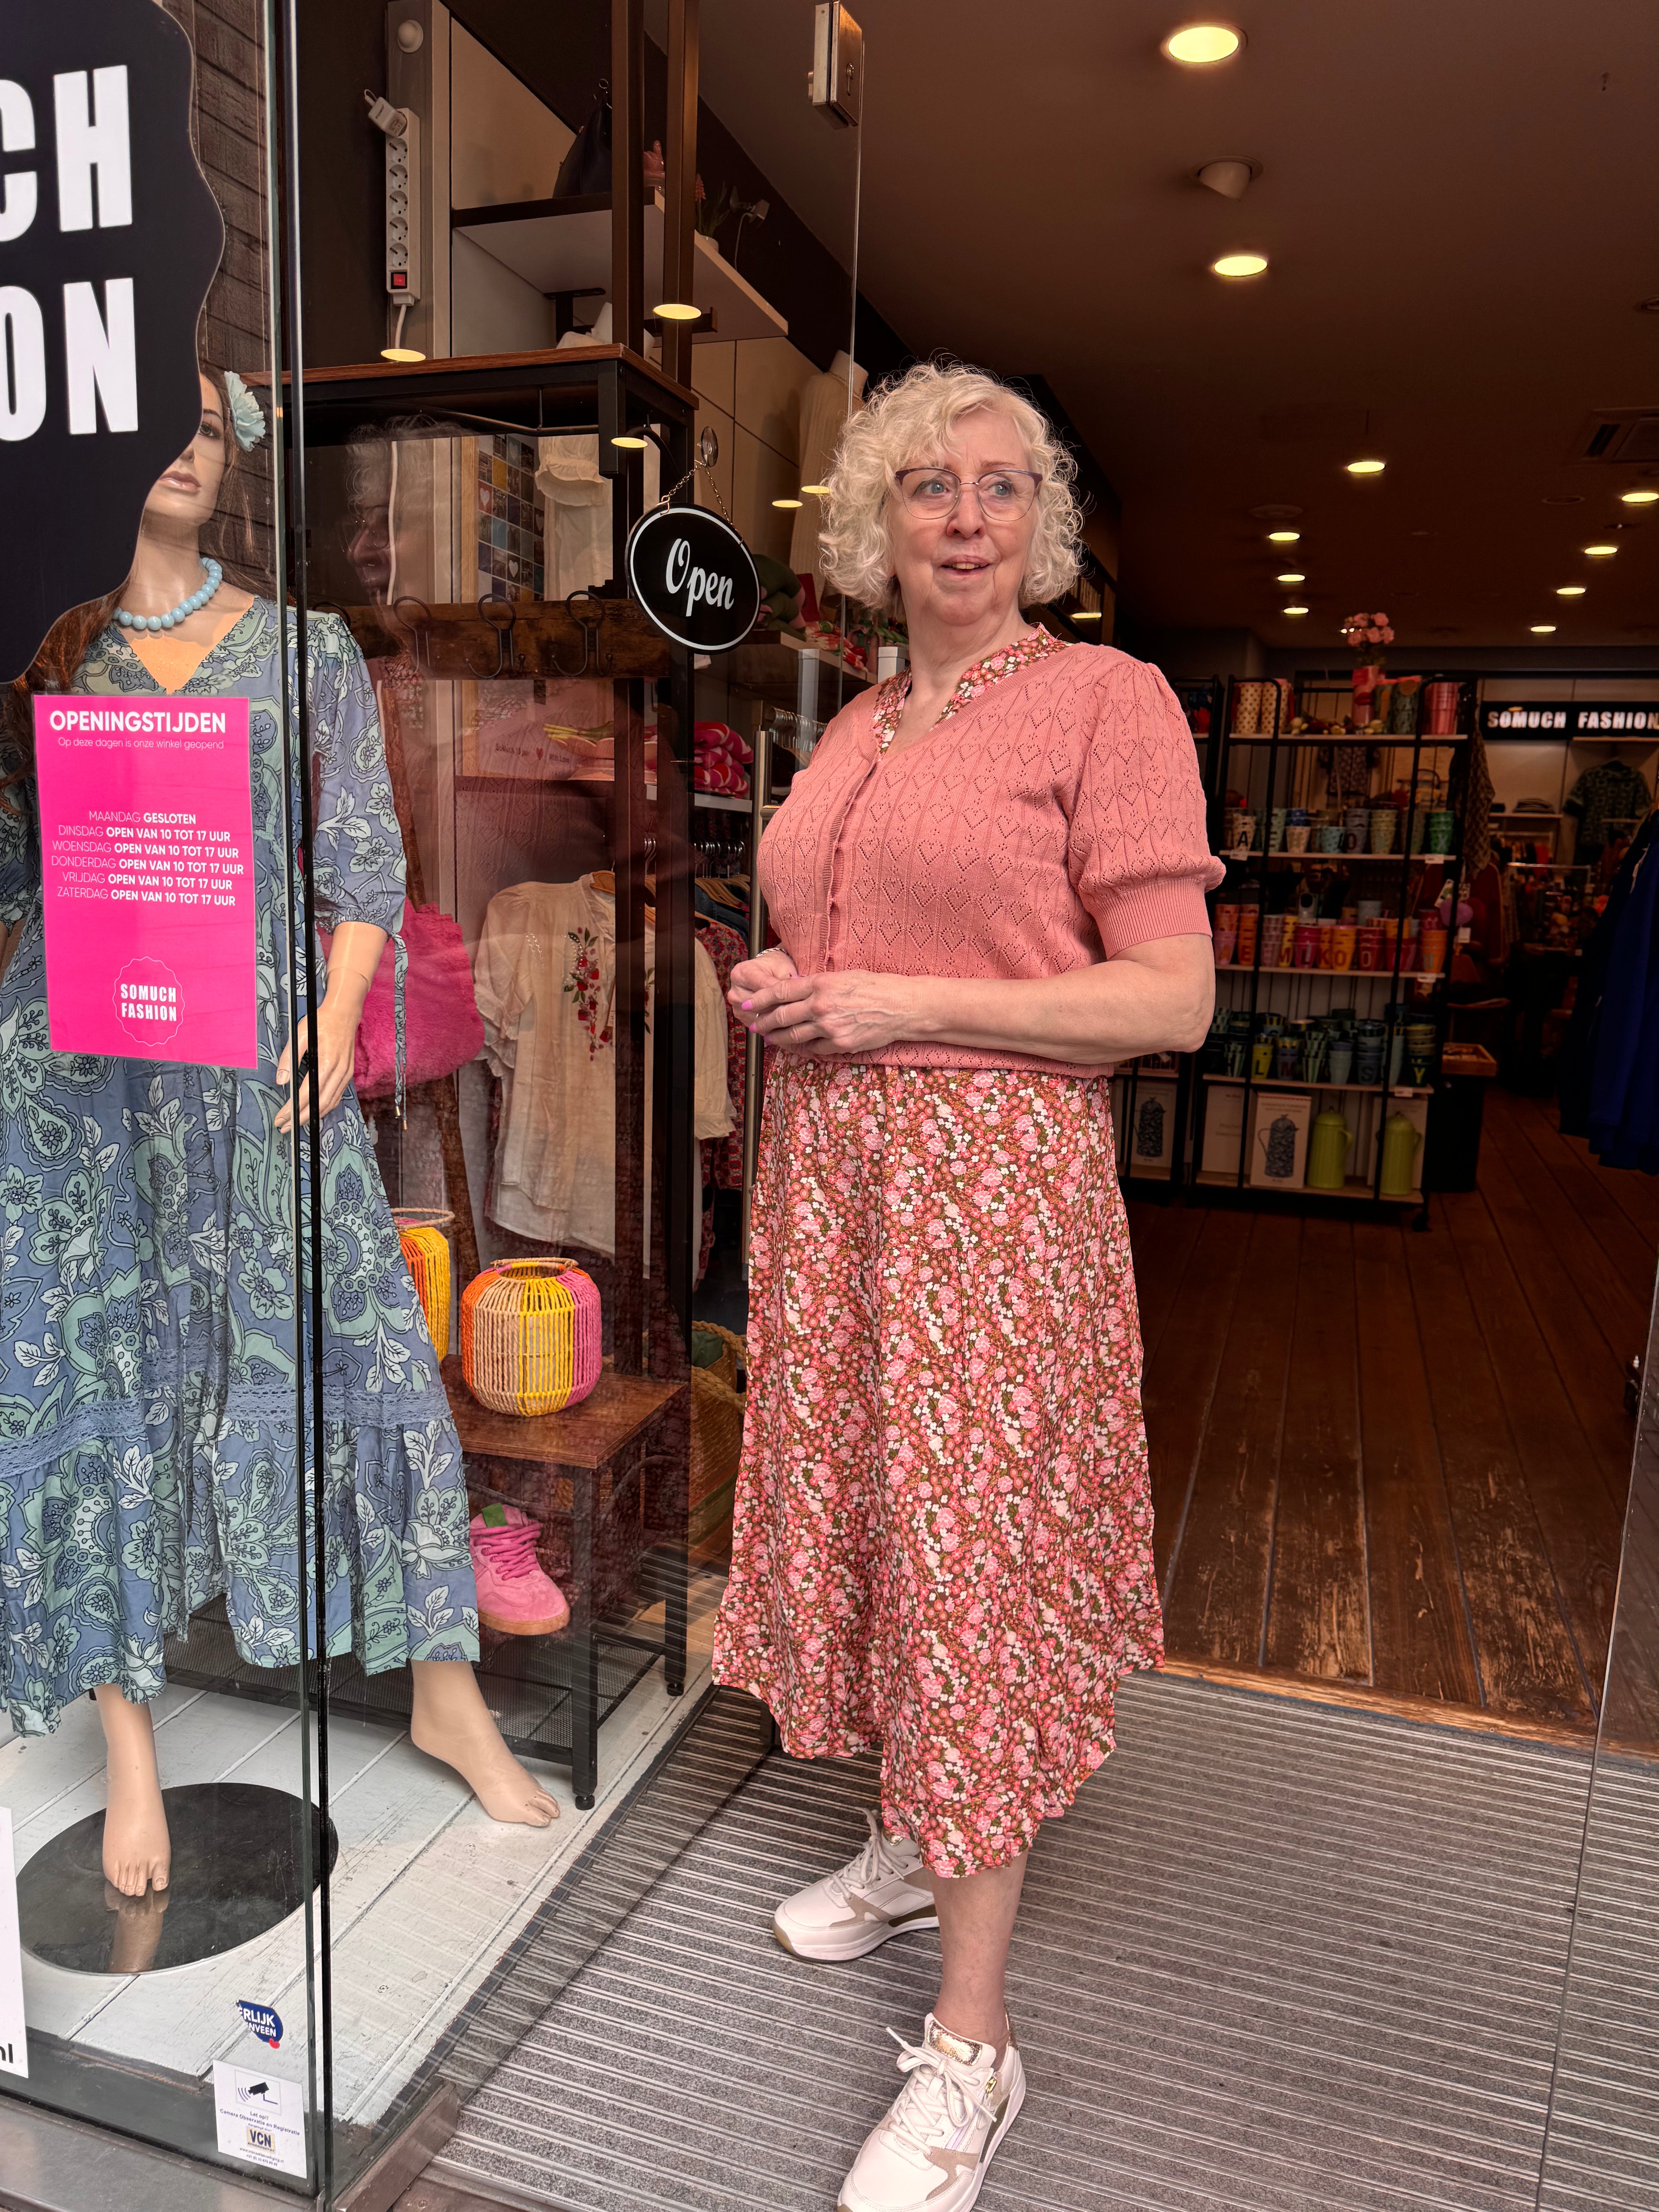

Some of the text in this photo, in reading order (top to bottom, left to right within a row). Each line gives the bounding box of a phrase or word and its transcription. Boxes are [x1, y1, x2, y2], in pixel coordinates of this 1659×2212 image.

[666, 538, 734, 617] Open
[50, 710, 226, 733] OPENINGSTIJDEN
[1487, 711, 1659, 730] SOMUCH FASHION
[58, 737, 72, 748] Op
[73, 737, 93, 747] deze
[95, 738, 124, 749] dagen
[125, 738, 132, 747] is
[156, 738, 182, 748] winkel
[184, 740, 224, 751] geopend
[89, 810, 197, 825] MAANDAG GESLOTEN
[58, 824, 231, 842] DINSDAG OPEN VAN 10 TOT 17 UUR
[52, 840, 239, 858] WOENSDAG OPEN VAN 10 TOT 17 UUR
[51, 855, 244, 875] DONDERDAG OPEN VAN 10 TOT 17 UUR
[62, 871, 232, 890] VRIJDAG OPEN VAN 10 TOT 17 UUR
[57, 886, 235, 906] ZATERDAG OPEN VAN 10 TOT 17 UUR
[120, 983, 176, 1003] SOMUCH
[121, 1002, 177, 1022] FASHION
[220, 2108, 238, 2118] Camera
[239, 2114, 265, 2126] Observatie
[273, 2123, 300, 2136] Registratie
[249, 2129, 272, 2148] VCN
